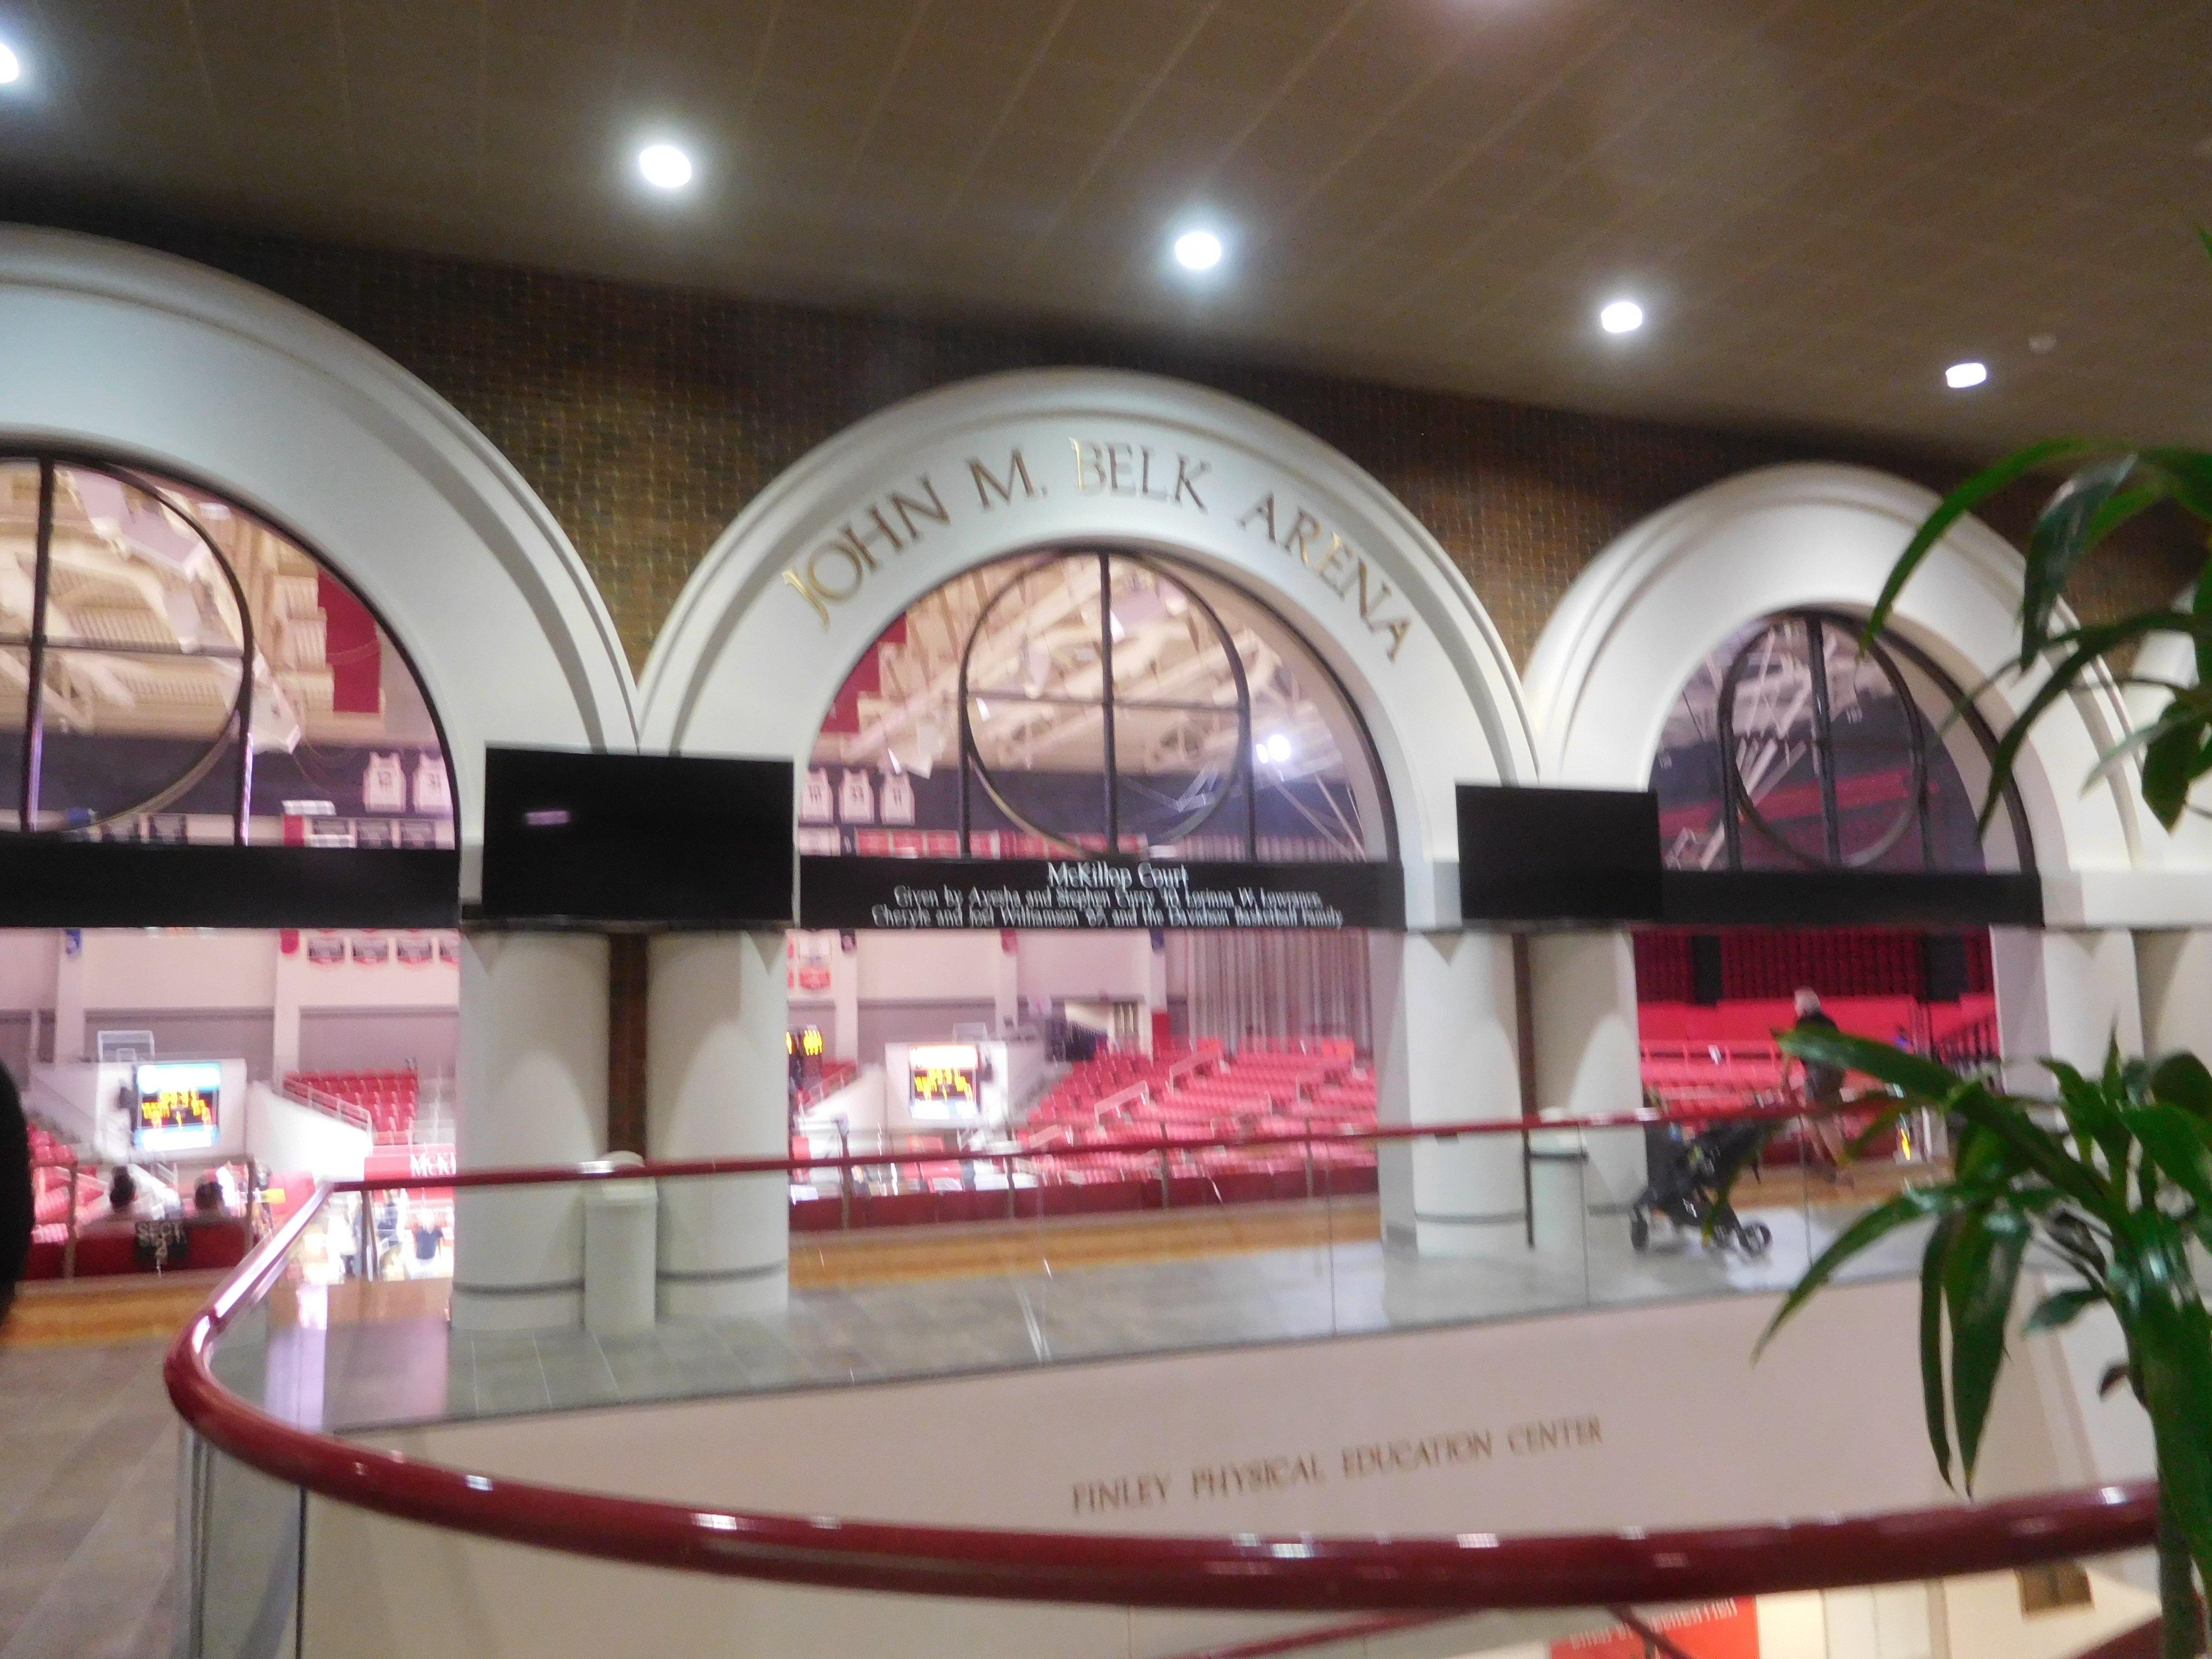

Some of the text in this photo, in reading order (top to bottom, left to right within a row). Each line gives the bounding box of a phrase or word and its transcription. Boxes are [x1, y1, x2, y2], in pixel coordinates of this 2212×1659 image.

[780, 436, 1412, 663] JOHN M. BELK ARENA
[1046, 860, 1189, 892] McKillop Court
[893, 884, 939, 908] Given
[943, 883, 963, 913] by
[968, 884, 1021, 913] Ayesha
[1025, 885, 1052, 908] and
[1056, 885, 1111, 911] Stephen
[936, 904, 963, 926] and
[1111, 904, 1138, 927] and
[1141, 904, 1164, 927] the
[1072, 1415, 1603, 1514] FINLEY PHYSICAL EDUCATION CENTER
